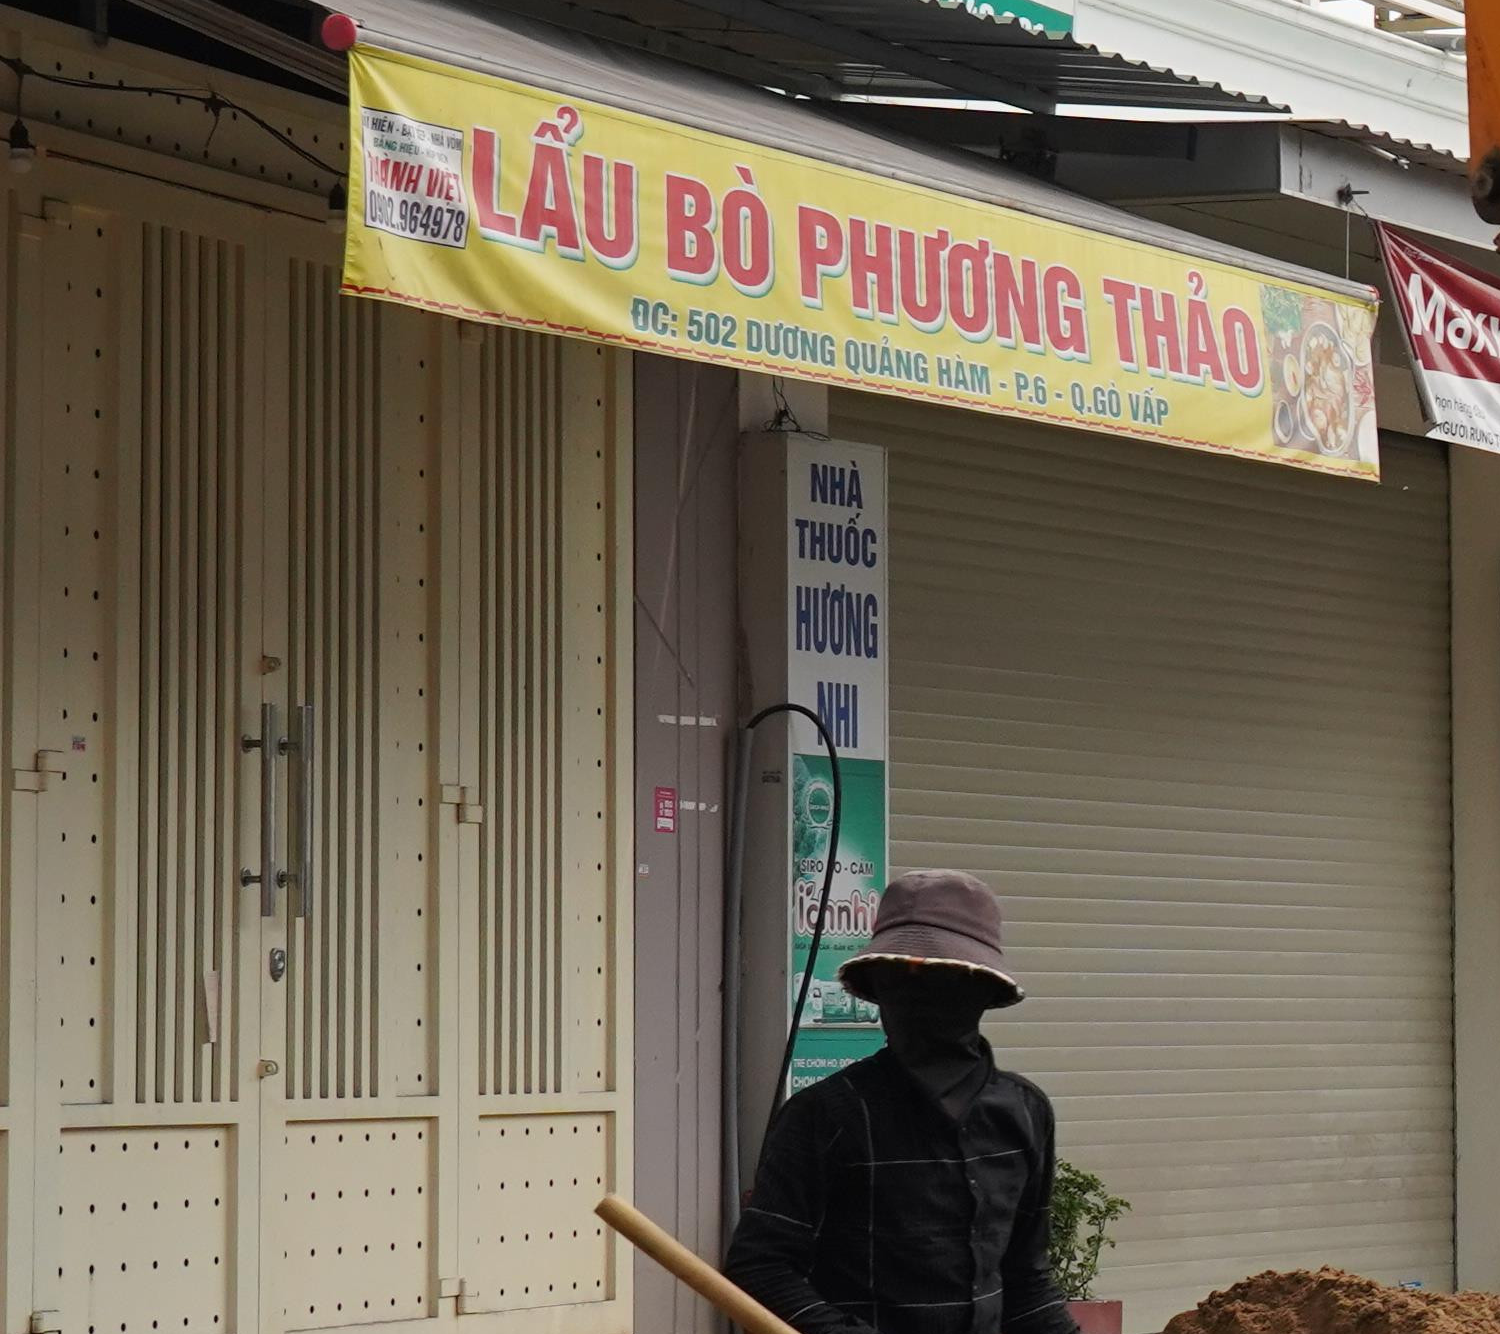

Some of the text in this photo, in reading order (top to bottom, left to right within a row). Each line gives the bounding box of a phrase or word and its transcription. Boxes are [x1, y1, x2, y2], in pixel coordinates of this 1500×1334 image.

[470, 107, 1264, 398] LẨU BÒ PHƯƠNG THẢO
[631, 297, 1170, 427] ĐC: 502 DƯƠNG QUẢNG HÀM P.6 Q.GÒ VẤP
[810, 459, 863, 509] NHÀ
[795, 512, 878, 568] THUỐC
[795, 583, 878, 659] HƯƠNG
[816, 680, 858, 749] NHI
